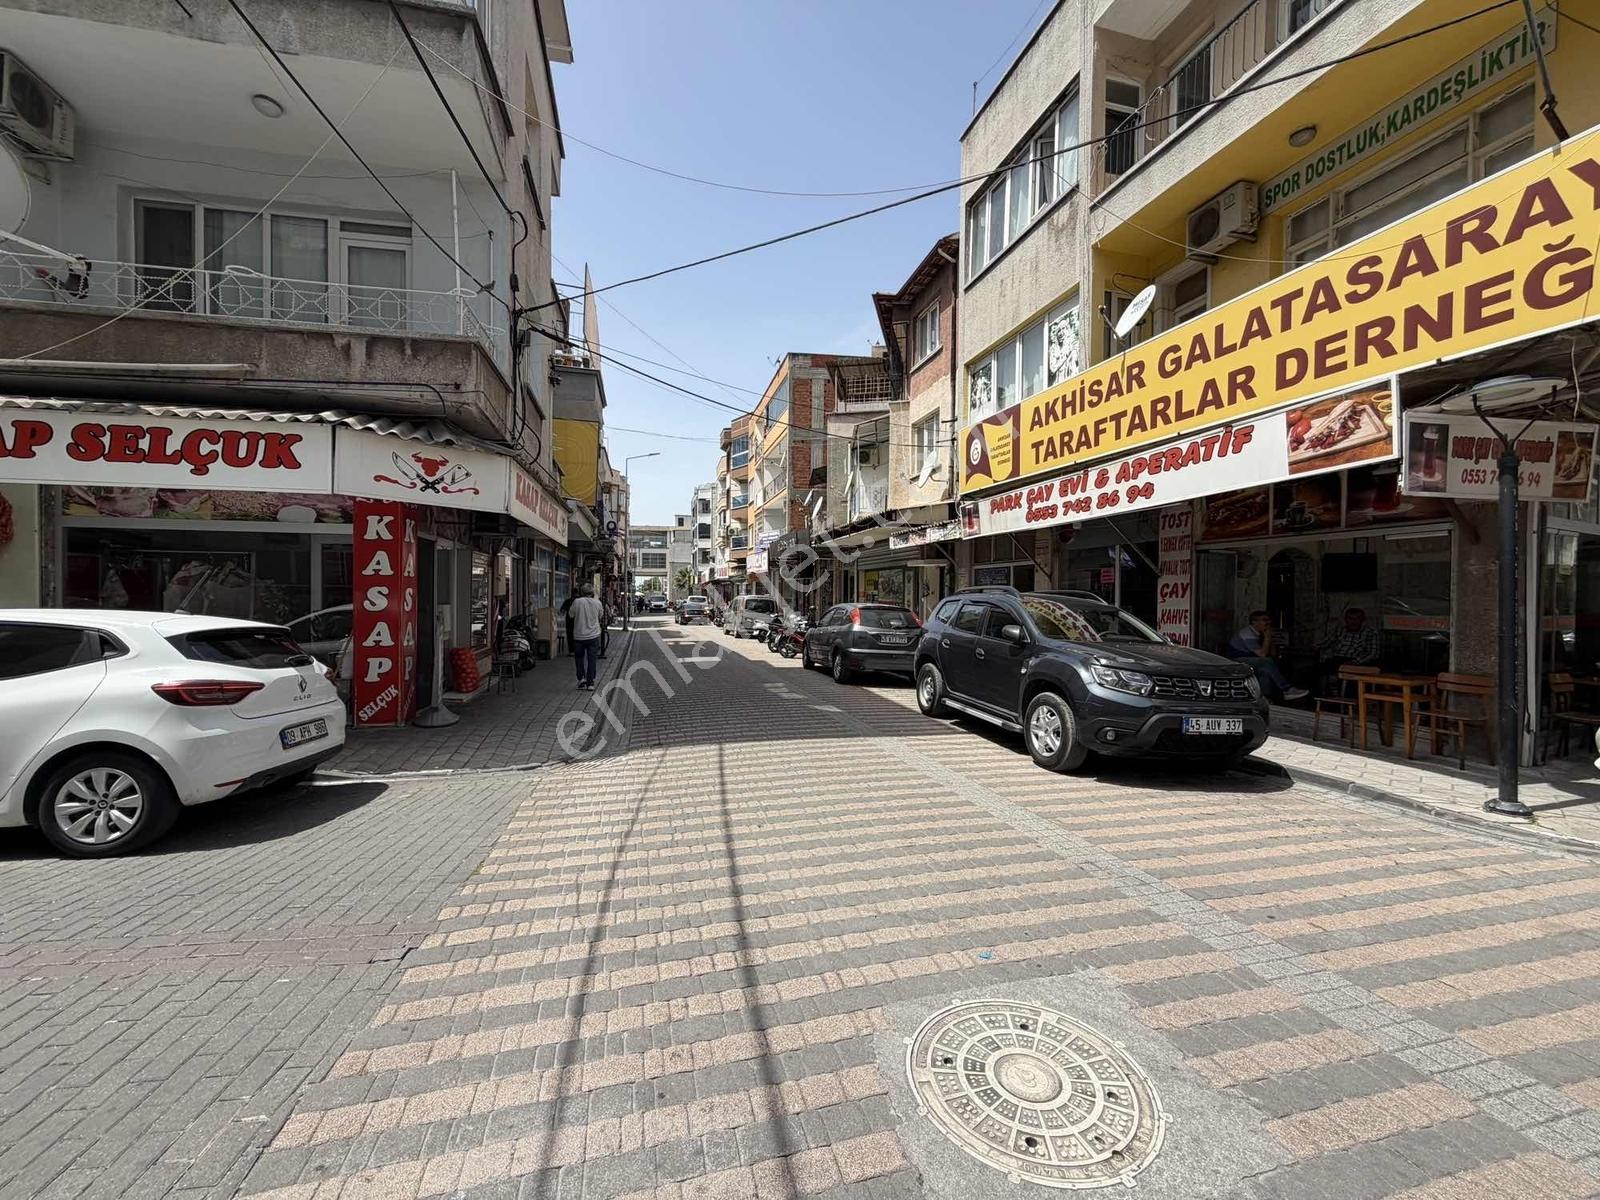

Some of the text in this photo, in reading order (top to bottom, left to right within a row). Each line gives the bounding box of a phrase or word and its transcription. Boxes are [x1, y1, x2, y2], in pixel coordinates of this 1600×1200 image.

[1265, 174, 1301, 208] SPOR
[1029, 359, 1147, 433] AKHİSAR
[1031, 365, 1257, 465] TARAFTARLAR
[66, 421, 304, 476] SELÇUK
[990, 423, 1256, 515] PARK ÇAY EVİ & APERATİF
[1461, 468, 1488, 485] 0553
[1527, 472, 1541, 488] 94
[1025, 481, 1155, 524] 0553 742 86 94
[1161, 511, 1192, 531] TOST
[361, 514, 396, 683] KASAP
[402, 517, 416, 681] KASAP
[1159, 582, 1190, 603] ÇAY
[1161, 608, 1189, 625] KAHVE
[358, 684, 399, 721] SELÇUK
[1190, 719, 1201, 731] 45
[1225, 719, 1241, 731] 337
